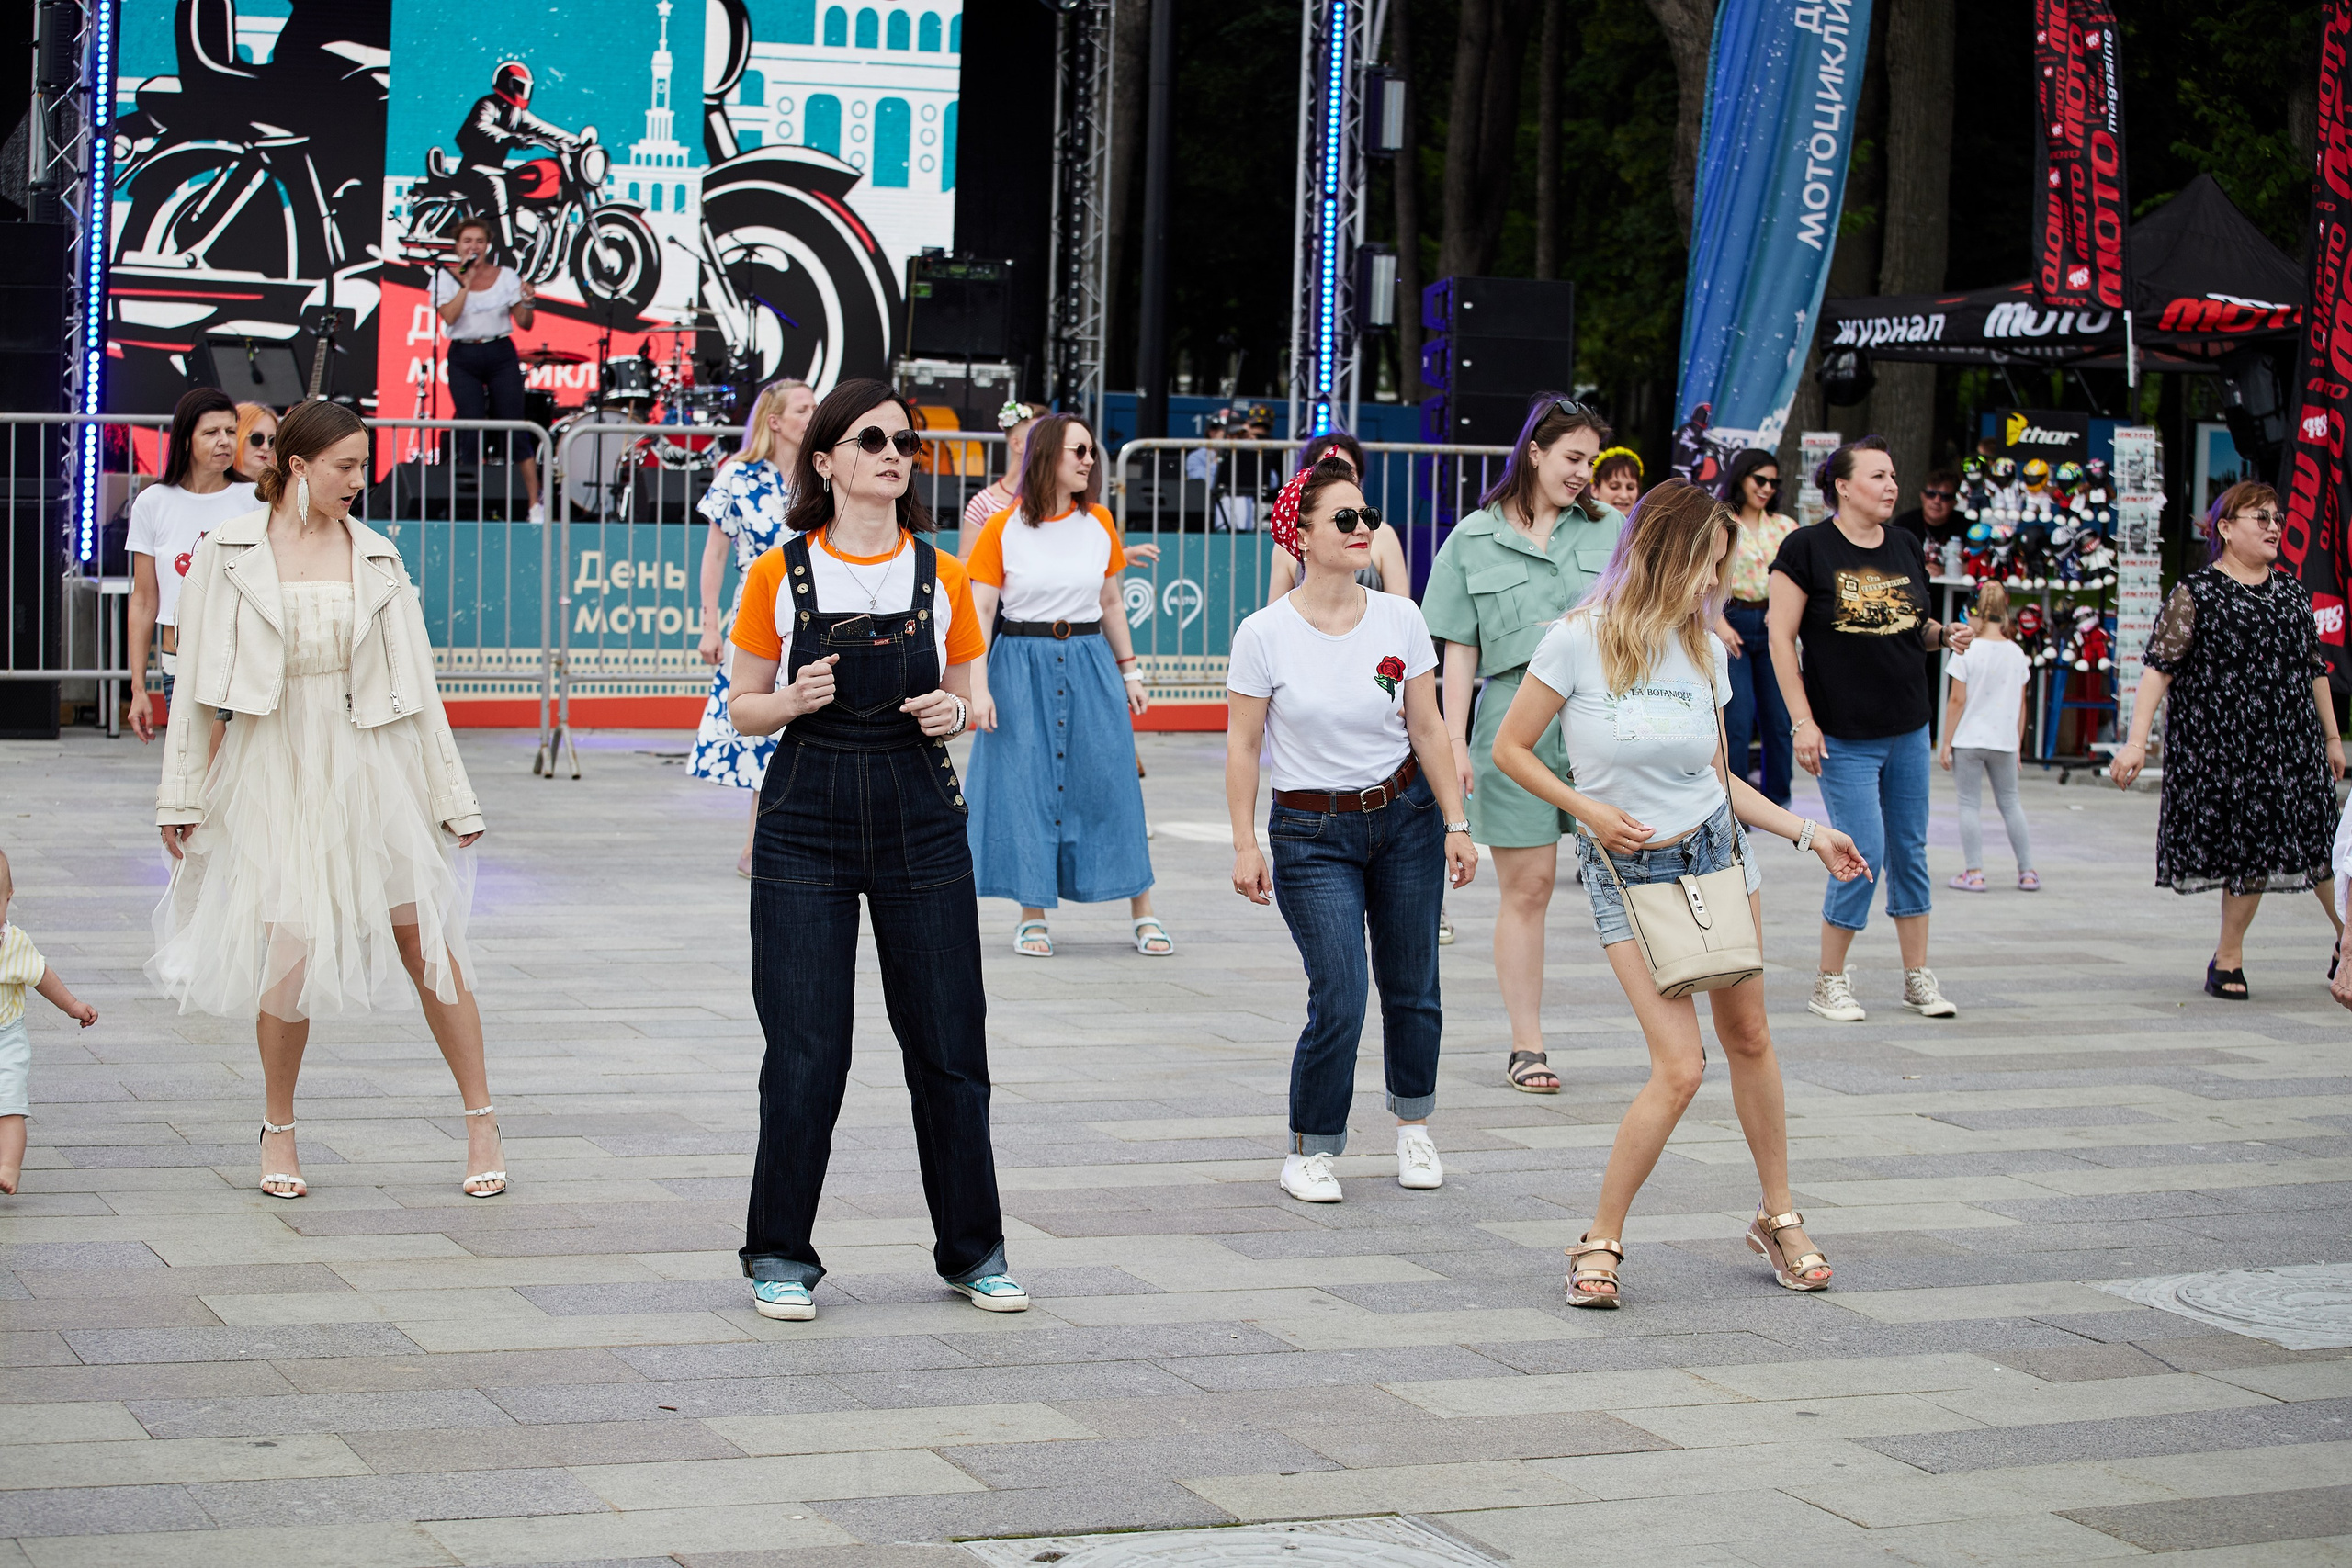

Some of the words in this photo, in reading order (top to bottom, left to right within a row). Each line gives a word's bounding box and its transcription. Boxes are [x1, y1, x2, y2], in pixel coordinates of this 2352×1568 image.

[2102, 28, 2119, 133] magazine
[1833, 313, 1947, 349] журнал
[2018, 426, 2080, 446] thor
[573, 550, 687, 595] День
[1632, 688, 1644, 696] LA
[1647, 688, 1693, 700] BOTANIQUE
